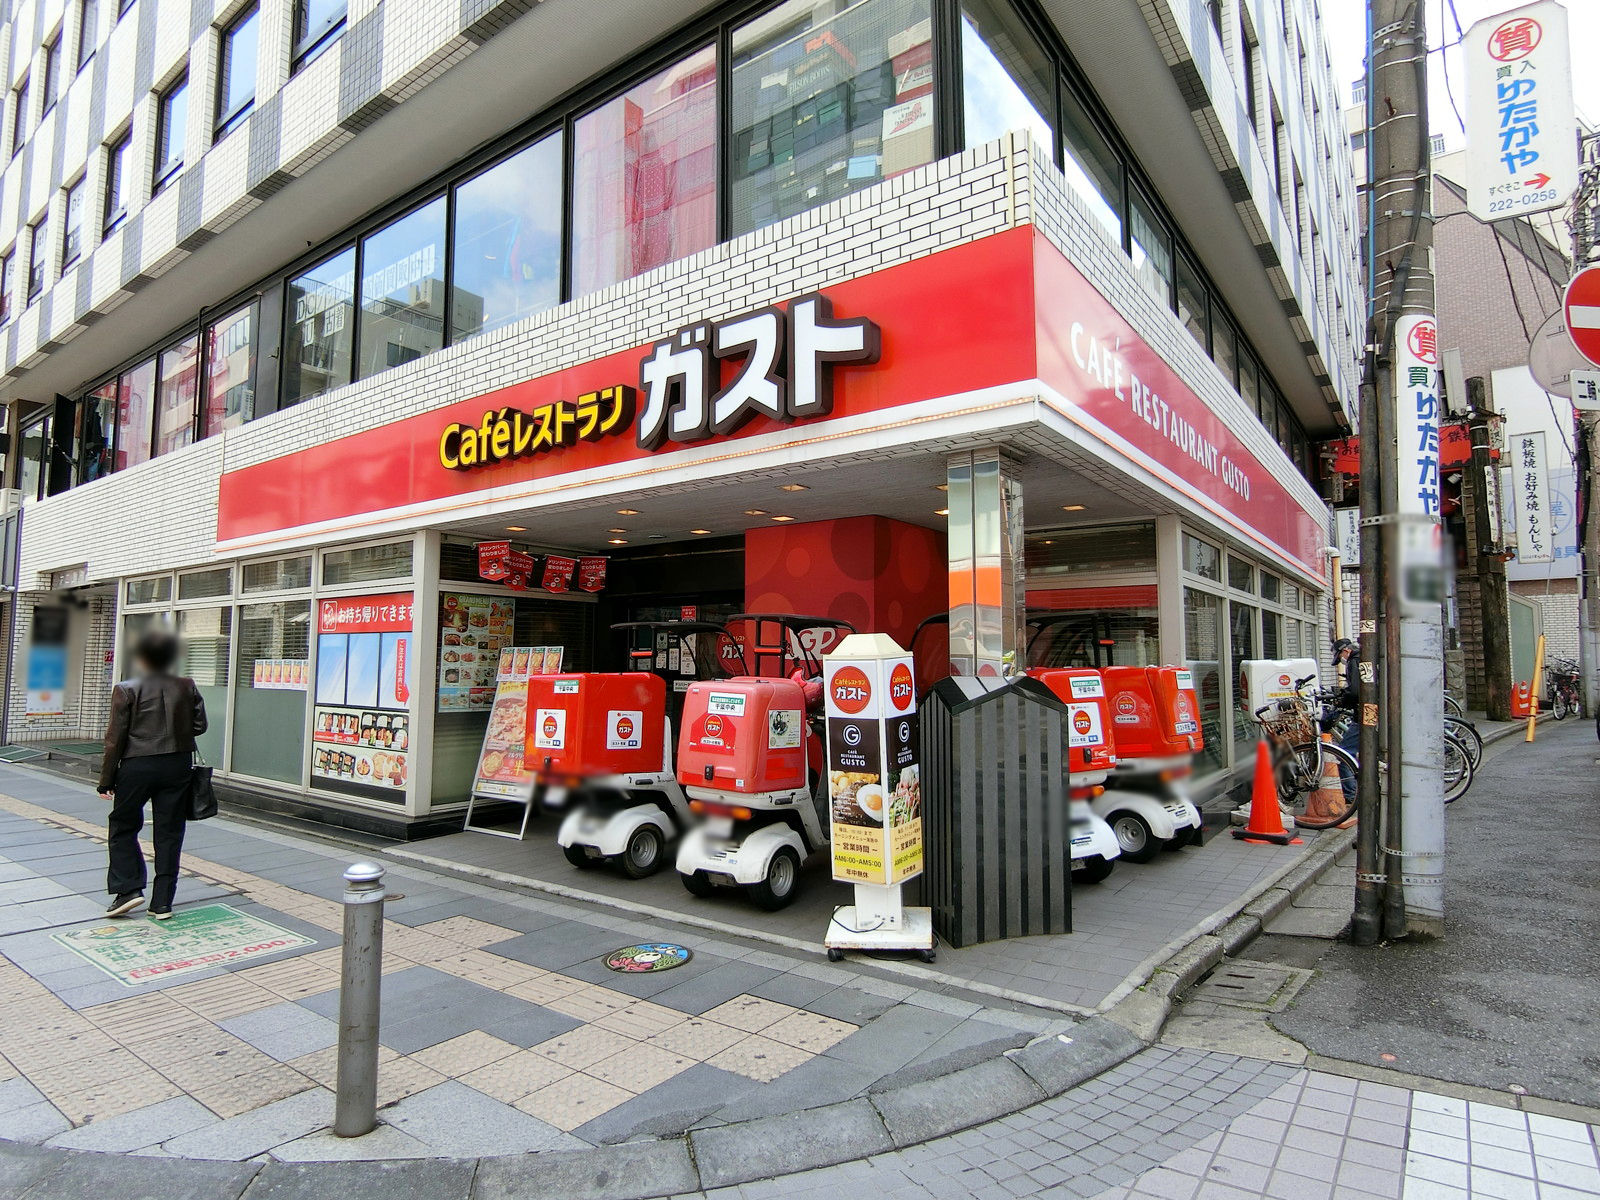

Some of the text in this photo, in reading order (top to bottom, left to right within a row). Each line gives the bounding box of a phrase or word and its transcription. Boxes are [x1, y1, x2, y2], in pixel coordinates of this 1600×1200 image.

[1497, 79, 1540, 175] ゆたかや
[1488, 183, 1521, 197] すぐそこ
[1488, 189, 1557, 213] 222-0258
[637, 297, 866, 439] ガスト
[1577, 380, 1600, 400] 二輪
[1070, 322, 1250, 501] CAFÉ RESTAURANT GUSTO
[1522, 438, 1537, 469] 鉄板焼
[1524, 471, 1540, 511] お好み焼
[1528, 514, 1543, 551] もんじゃ
[836, 686, 867, 700] ガスト
[893, 683, 912, 697] ガスト
[1075, 721, 1091, 729] ガスト
[845, 728, 859, 743] G
[840, 758, 866, 767] GUSTO
[898, 754, 913, 764] GUSTO
[842, 842, 870, 854] 営業時間
[846, 868, 869, 878] 年中無休
